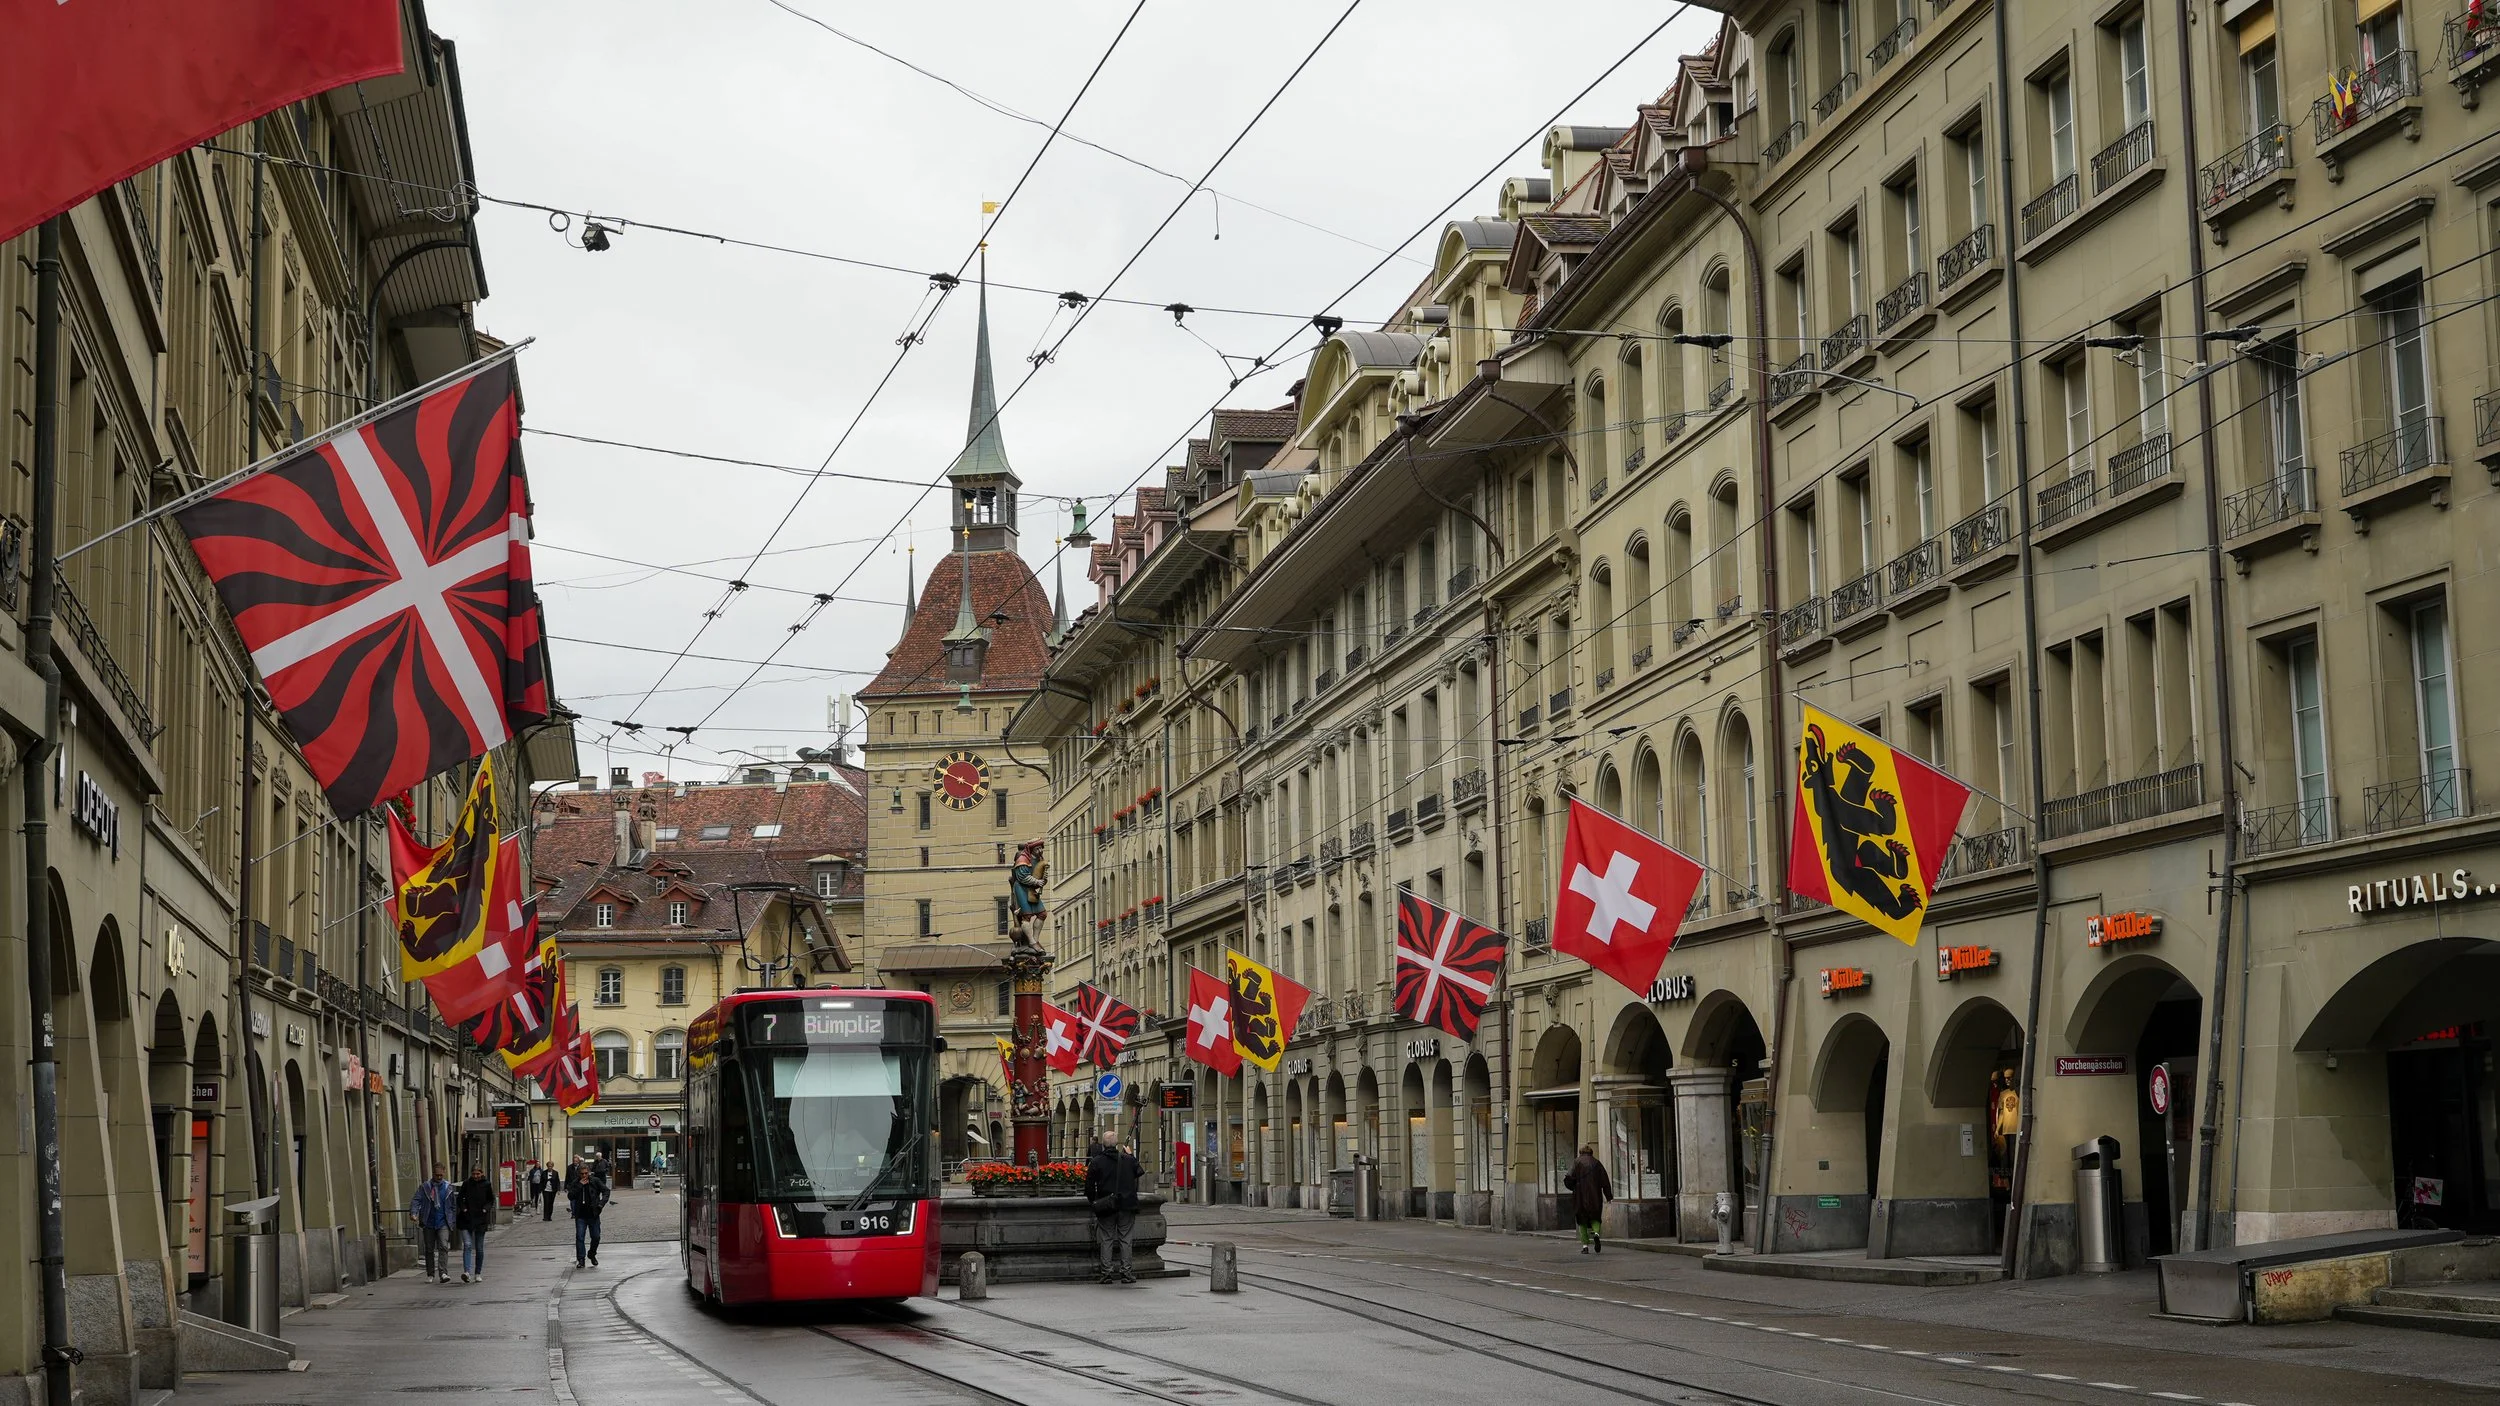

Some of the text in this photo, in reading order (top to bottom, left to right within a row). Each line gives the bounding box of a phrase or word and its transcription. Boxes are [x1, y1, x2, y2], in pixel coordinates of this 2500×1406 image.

[79, 770, 117, 849] DEPOT
[2103, 911, 2154, 942] Müller
[1951, 945, 1993, 971] Müller
[1831, 967, 1865, 990] Müller
[763, 1014, 881, 1041] 7 Bümpliz
[1405, 1038, 1435, 1059] GLOBUS
[1287, 1058, 1308, 1075] GLOBUS
[2060, 1059, 2123, 1073] Storchengässchen
[604, 1113, 645, 1125] Fielmann
[859, 1215, 890, 1230] 916
